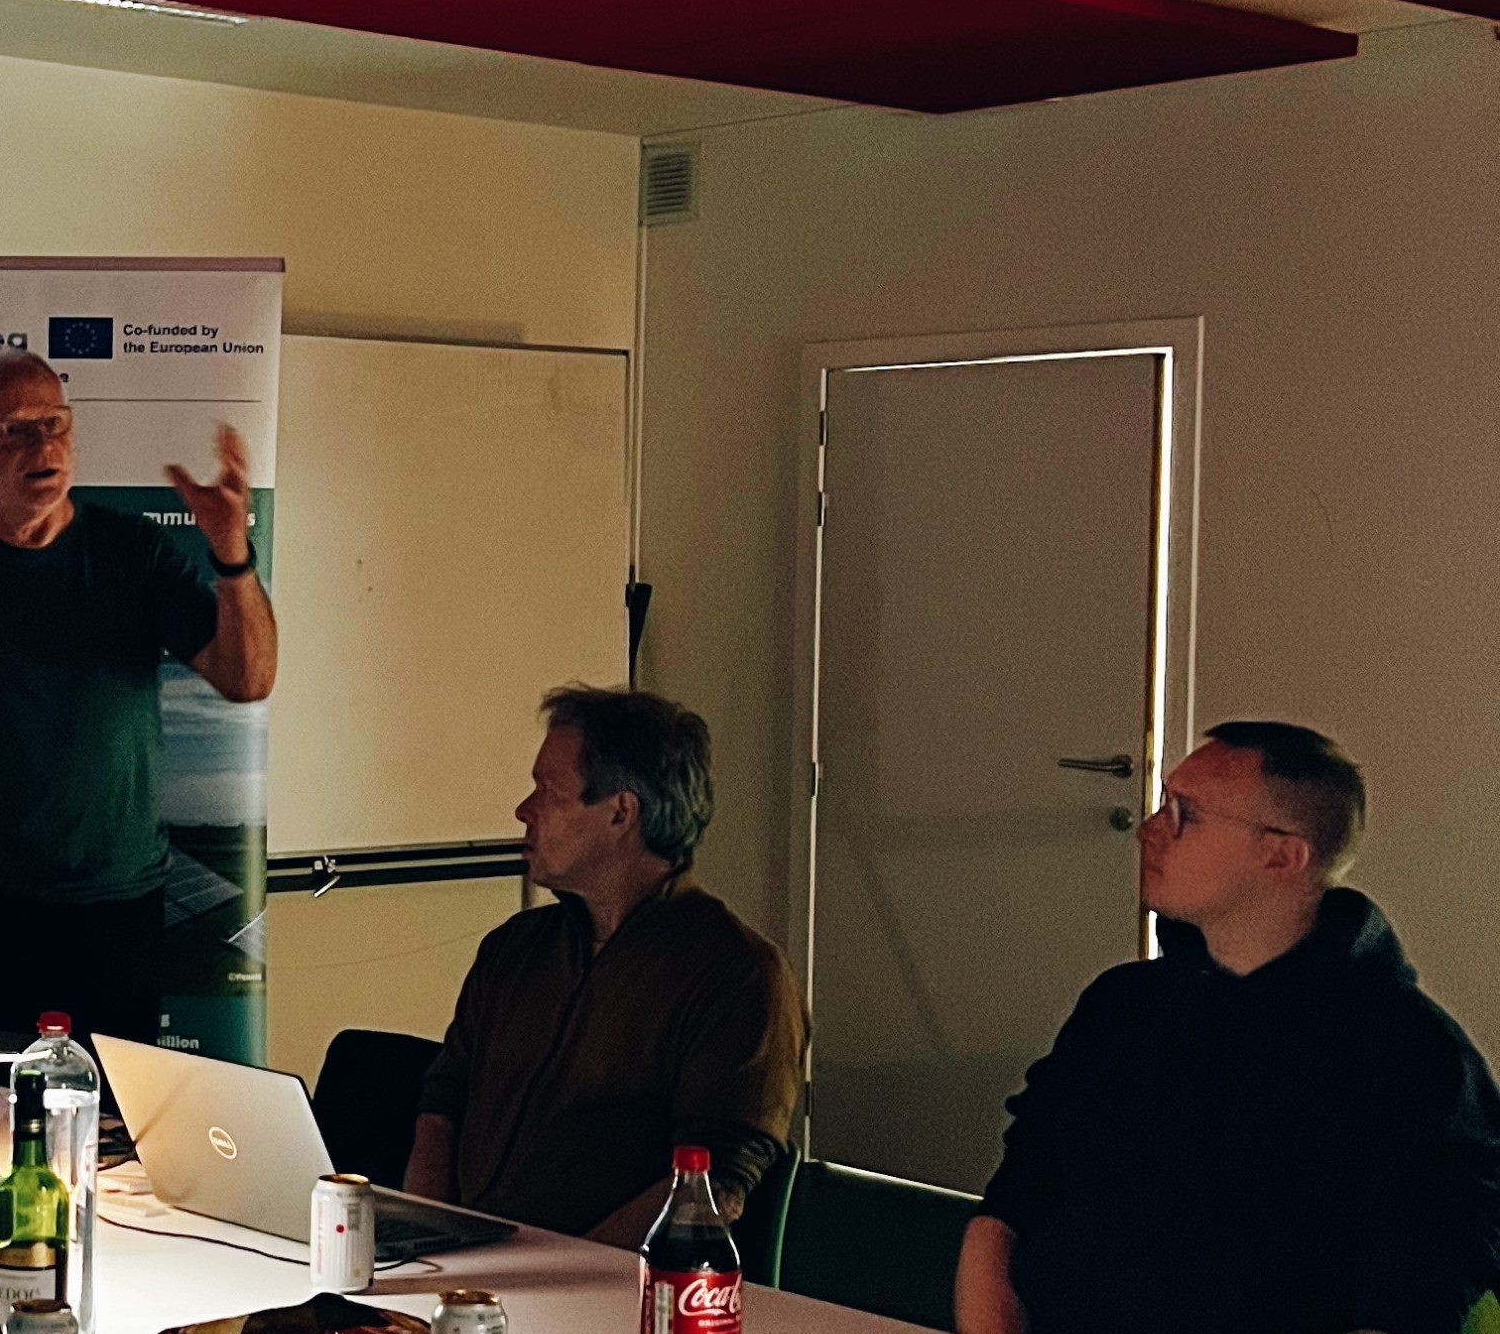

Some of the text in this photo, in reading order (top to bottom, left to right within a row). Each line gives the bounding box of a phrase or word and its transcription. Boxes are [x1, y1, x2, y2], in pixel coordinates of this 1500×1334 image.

[123, 324, 219, 339] Co-funded by
[123, 341, 264, 355] the European Union
[157, 1035, 199, 1049] illion
